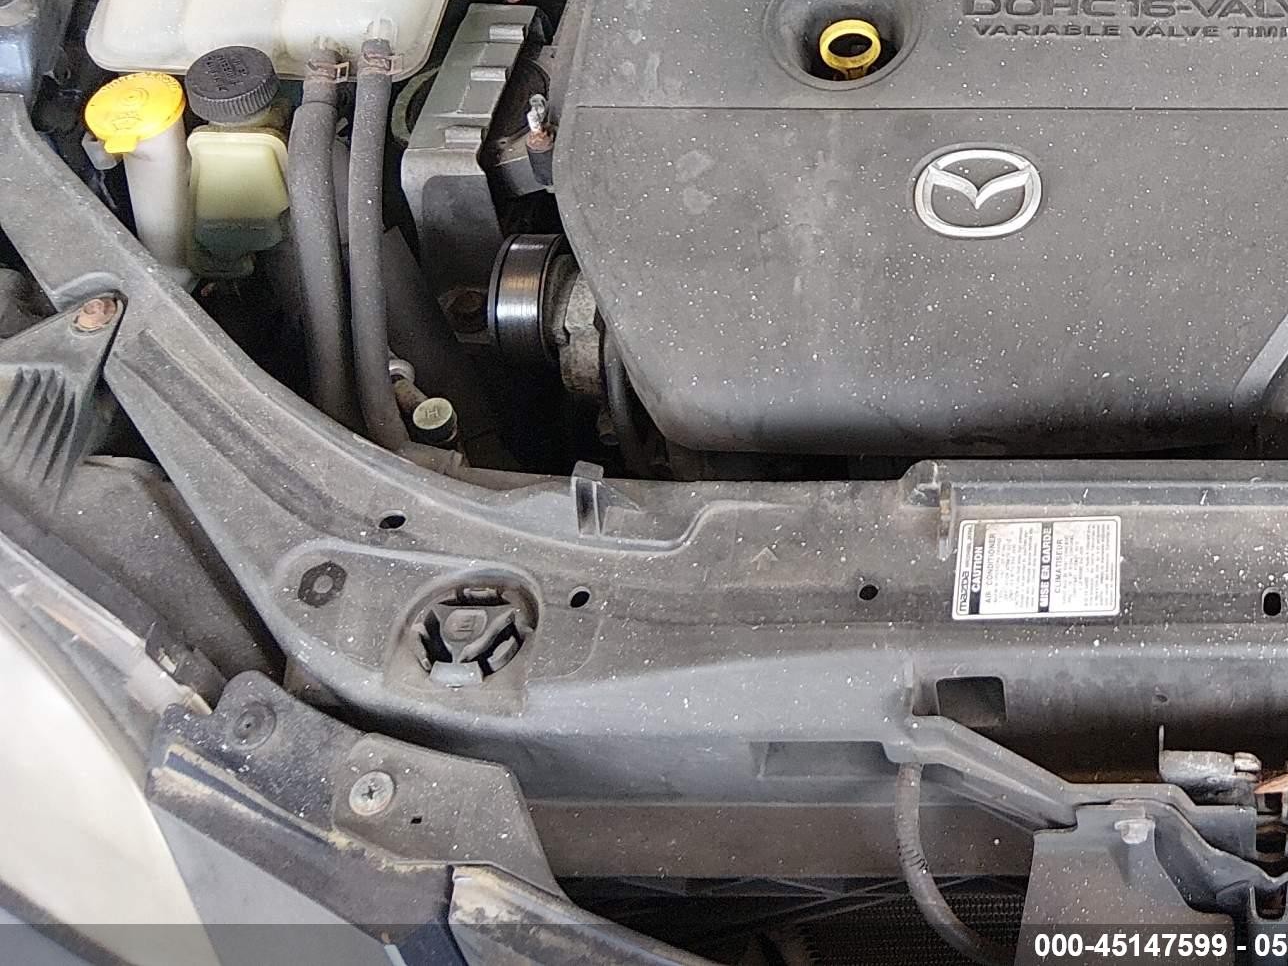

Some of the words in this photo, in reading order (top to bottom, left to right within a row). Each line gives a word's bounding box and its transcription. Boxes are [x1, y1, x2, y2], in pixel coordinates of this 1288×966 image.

[973, 23, 1120, 37] VARIABLE
[1129, 25, 1220, 38] VALVE
[1043, 527, 1052, 562] GARDE
[971, 546, 983, 593] CAUTION
[1041, 563, 1050, 581] EN
[1039, 581, 1049, 608] MISE
